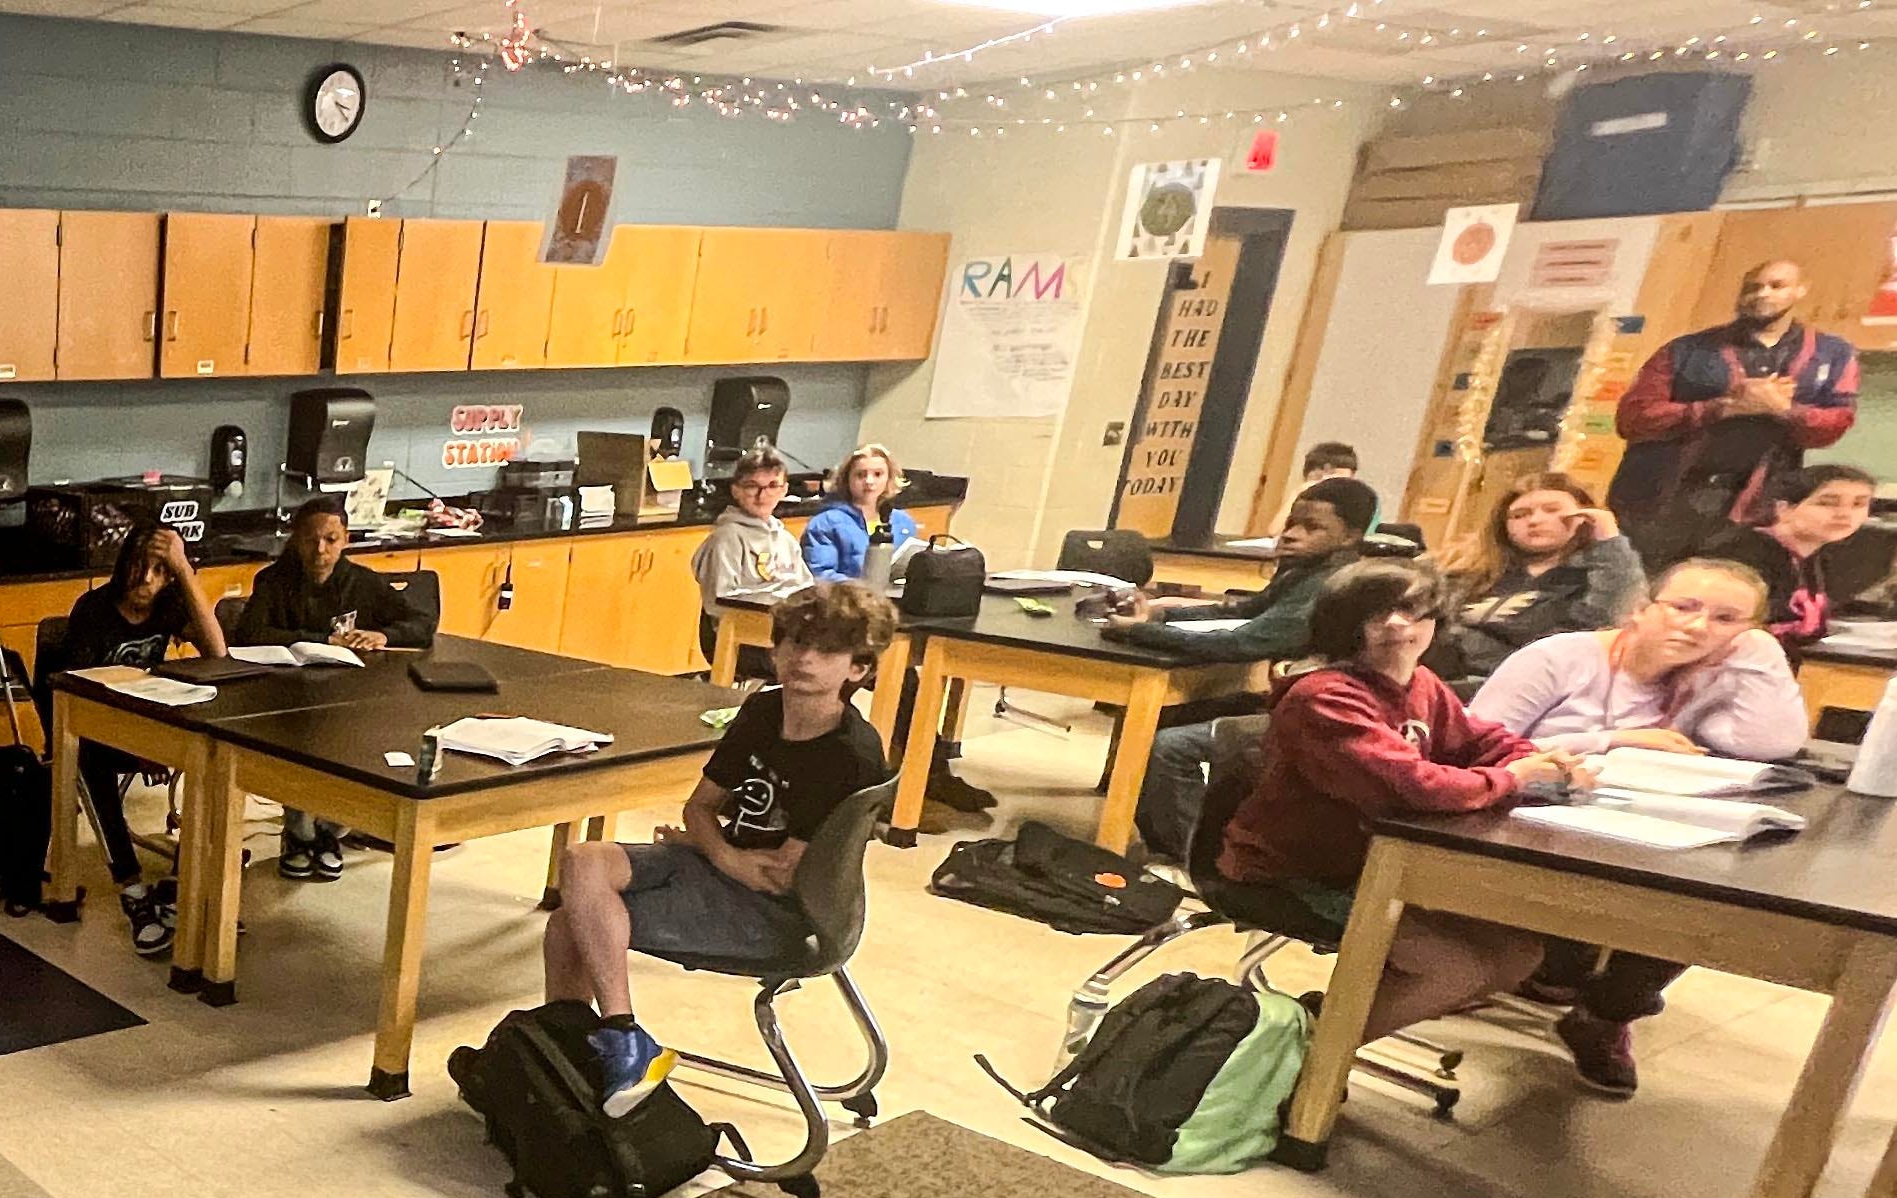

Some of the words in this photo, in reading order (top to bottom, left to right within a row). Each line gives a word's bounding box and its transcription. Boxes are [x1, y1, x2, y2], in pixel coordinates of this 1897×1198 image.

[1178, 299, 1219, 318] HAD
[1171, 329, 1212, 348] THE
[1159, 360, 1211, 380] BEST
[1157, 390, 1198, 409] DAY
[452, 406, 522, 433] SUPPLY
[1145, 420, 1194, 439] WITH
[1145, 448, 1183, 468] YOU
[162, 504, 196, 519] SUB
